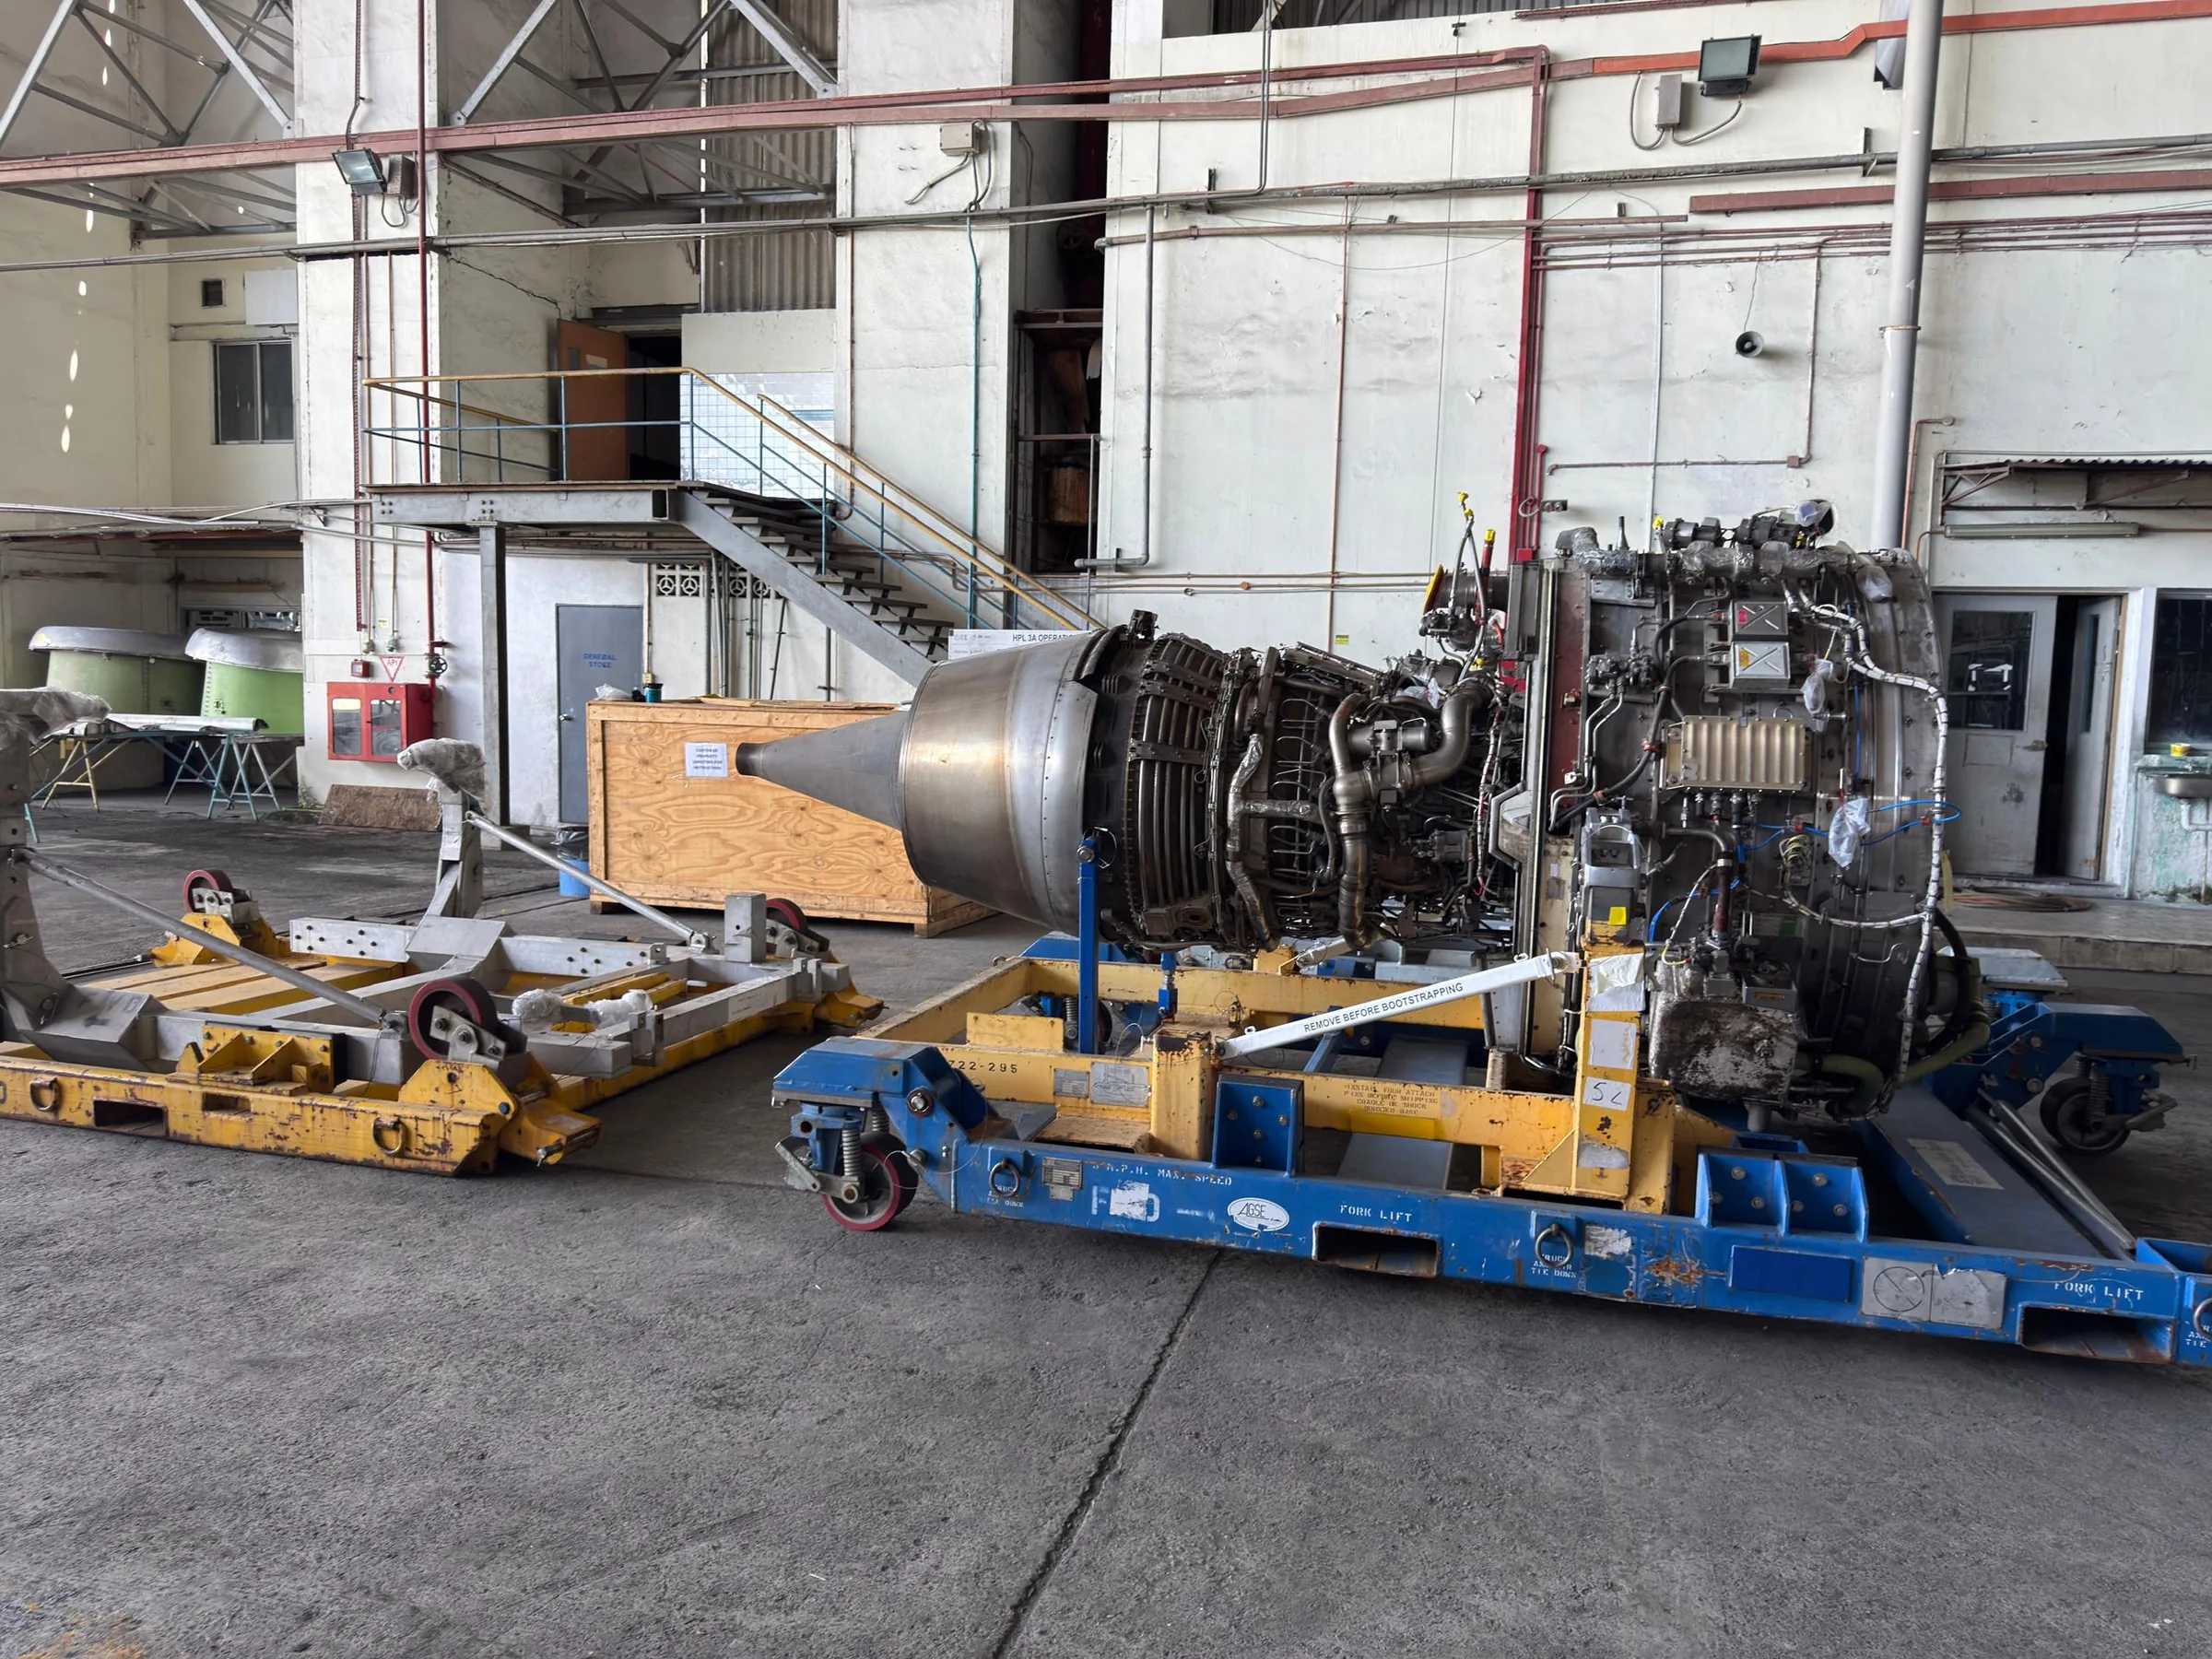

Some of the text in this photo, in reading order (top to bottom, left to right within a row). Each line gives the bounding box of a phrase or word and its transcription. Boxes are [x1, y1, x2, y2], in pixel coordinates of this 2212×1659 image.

[1303, 982, 1464, 1033] REMOVE BEFORE BOOTSTRAPPING
[1194, 1173, 1232, 1186] SPEED
[1238, 1202, 1266, 1218] AGSE
[1340, 1204, 1412, 1222] FORK LIFT
[2054, 1282, 2144, 1300] FORK LIFT
